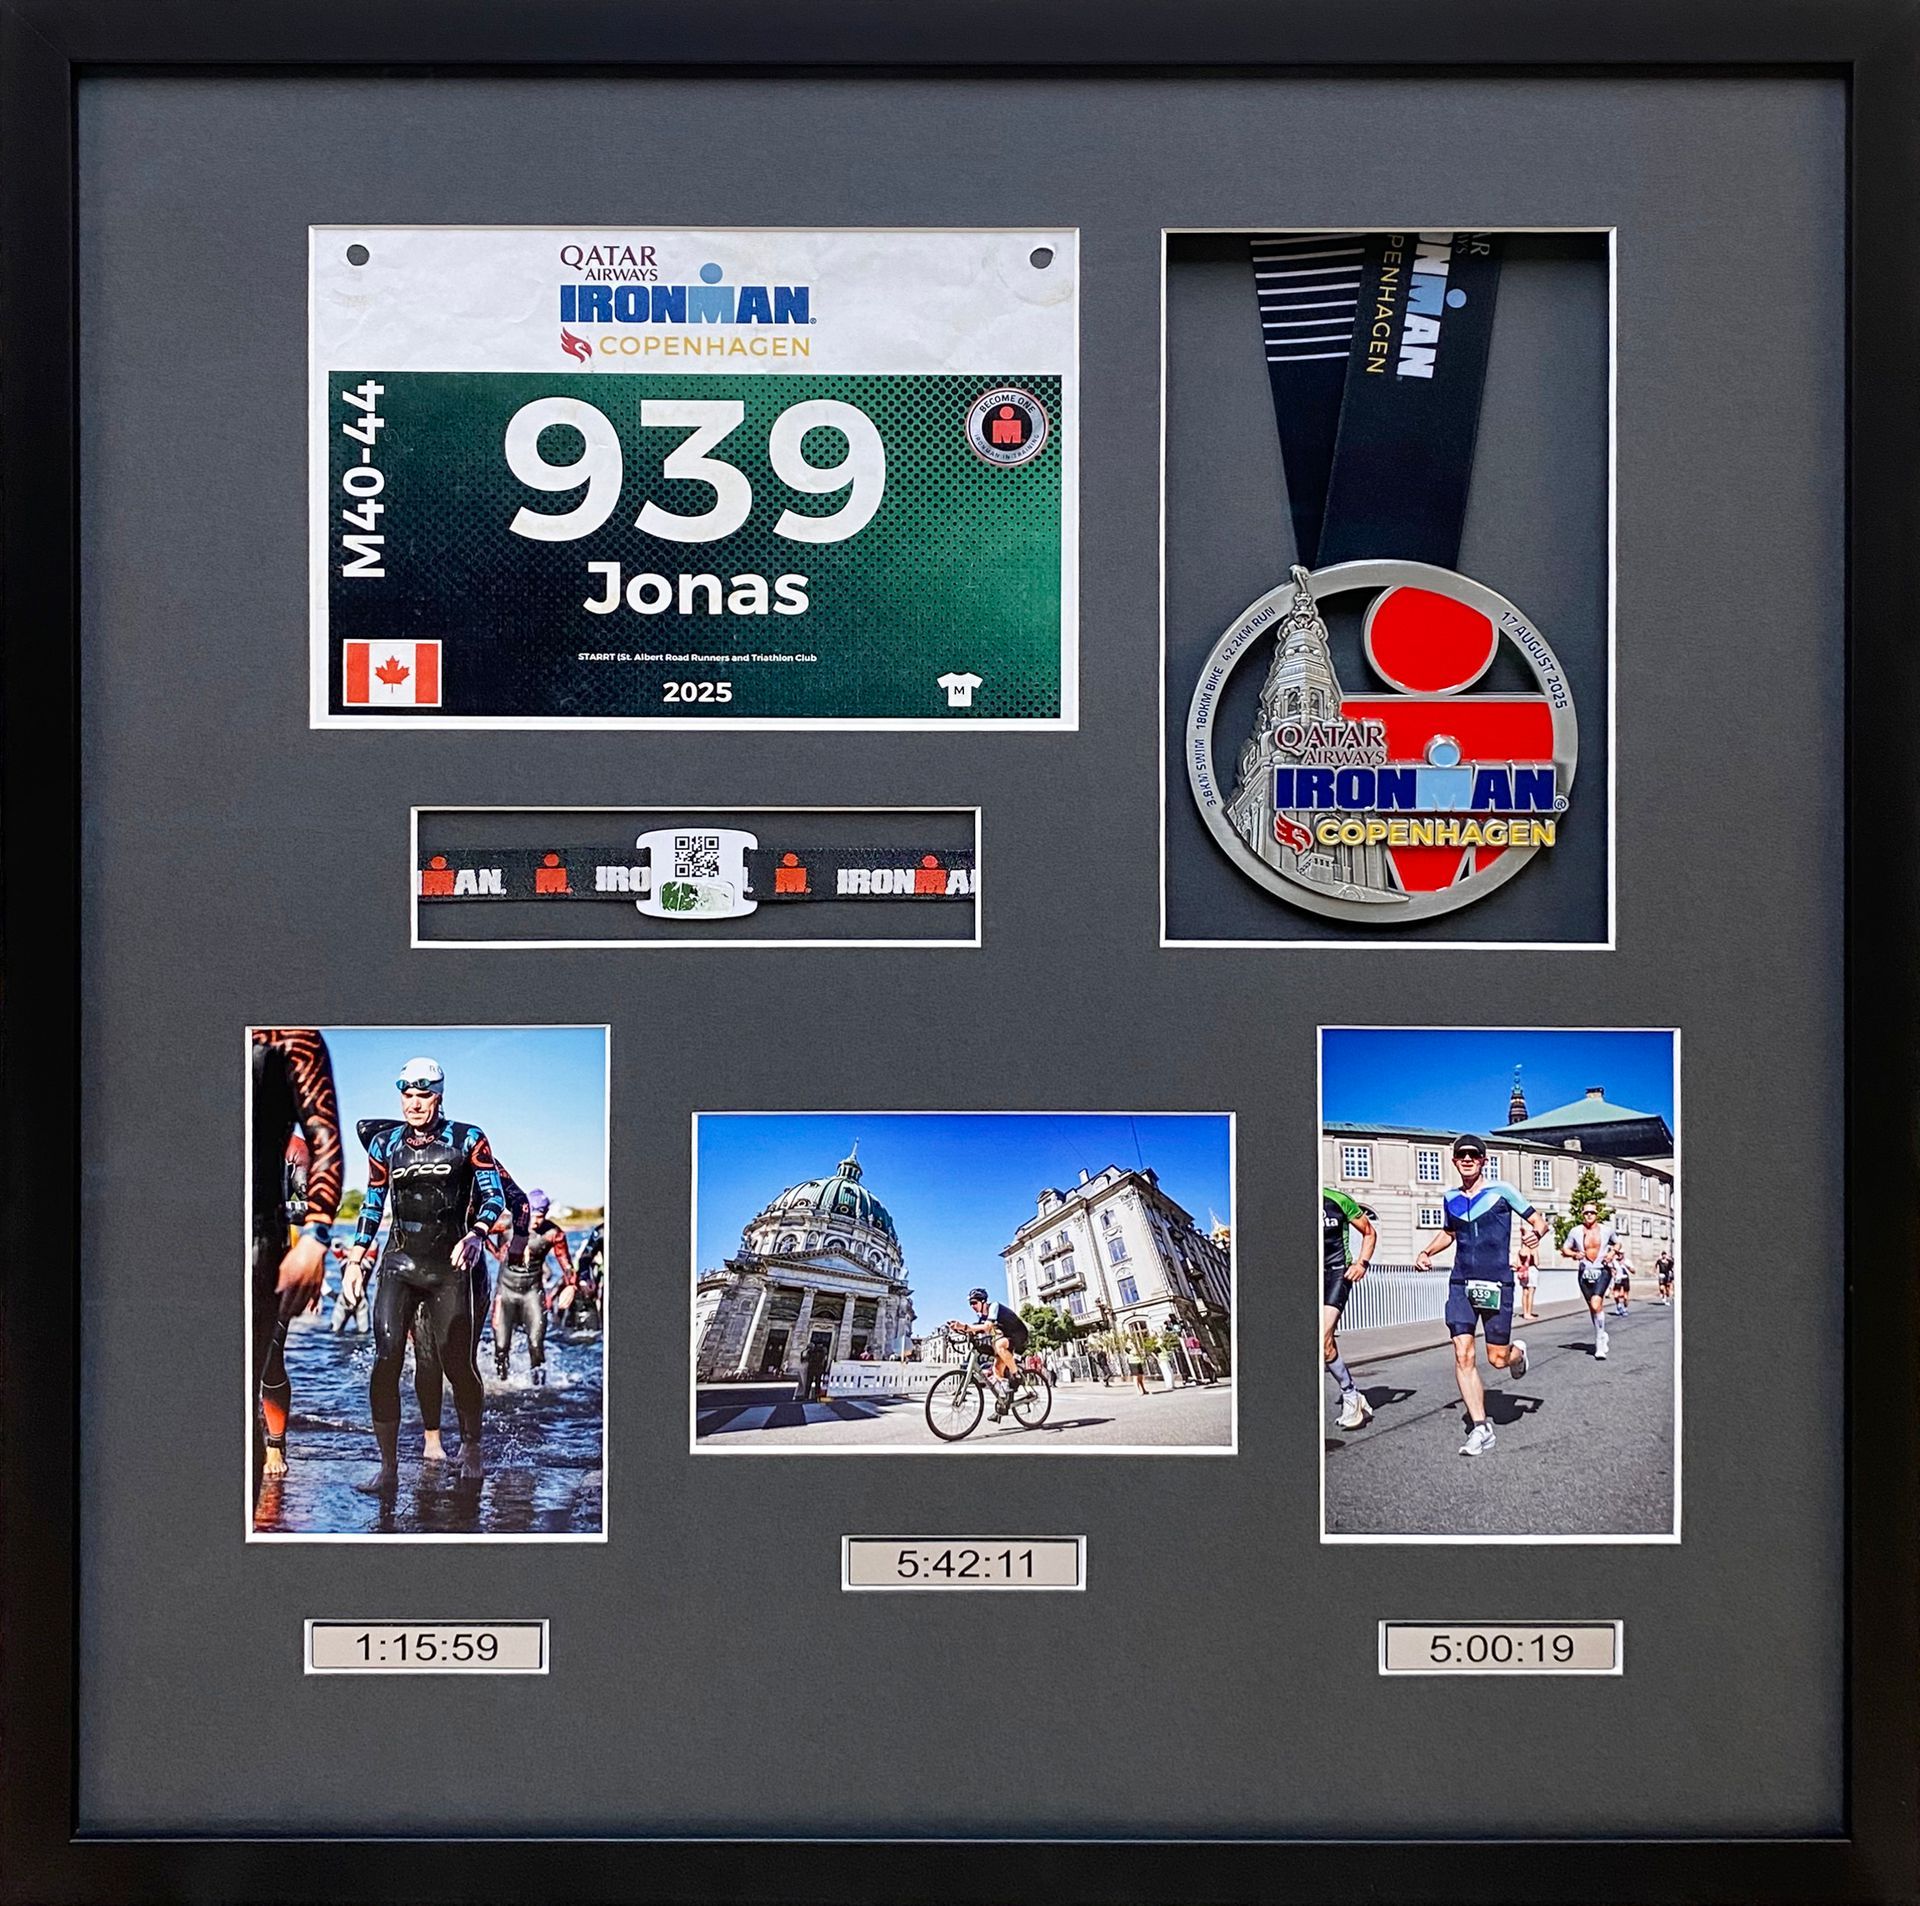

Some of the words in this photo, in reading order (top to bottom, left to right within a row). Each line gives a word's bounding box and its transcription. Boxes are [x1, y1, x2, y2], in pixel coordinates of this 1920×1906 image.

[560, 245, 658, 270] QATAR
[585, 268, 658, 281] AIRWAYS
[560, 262, 810, 324] IRONMAN
[599, 336, 810, 356] COPENHAGEN
[979, 394, 1017, 413] BECOME
[1017, 397, 1036, 414] ONE
[974, 434, 1000, 458] IRONMAN
[1012, 434, 1040, 458] TRAINING
[342, 380, 385, 578] M40-44
[504, 396, 887, 544] 939
[582, 561, 810, 615] Jonas
[1253, 606, 1275, 627] RUN
[578, 653, 615, 661] STARRT
[617, 653, 632, 662] (St.
[634, 653, 664, 662] Albert
[665, 653, 690, 662] Road
[691, 653, 730, 662] Runners
[731, 653, 750, 662] and
[751, 653, 793, 662] Triathlon
[795, 653, 818, 662] Club
[1222, 626, 1253, 661] 42.2KM
[1502, 612, 1518, 626] 17
[1514, 626, 1555, 674] AUGUST
[1547, 675, 1568, 709] 2025
[663, 682, 732, 702] 2025
[954, 685, 965, 695] M
[1206, 666, 1224, 691] BIKE
[1196, 693, 1213, 730] 180KM
[1275, 723, 1385, 752] QATAR
[1195, 738, 1207, 771] SWIM
[1304, 751, 1385, 764] AIRWAYS
[1197, 772, 1217, 808] 3.8KM
[1275, 744, 1556, 811] IRONMAN
[1315, 818, 1556, 847] COPENHAGEN
[418, 856, 503, 895] MAN
[837, 855, 976, 895] IRONMA
[392, 1163, 452, 1179] orca
[1472, 1289, 1491, 1299] 939
[897, 1550, 1033, 1578] 5:42:11
[356, 1633, 498, 1661] 1:15:59
[1430, 1634, 1574, 1662] 5:00:19
